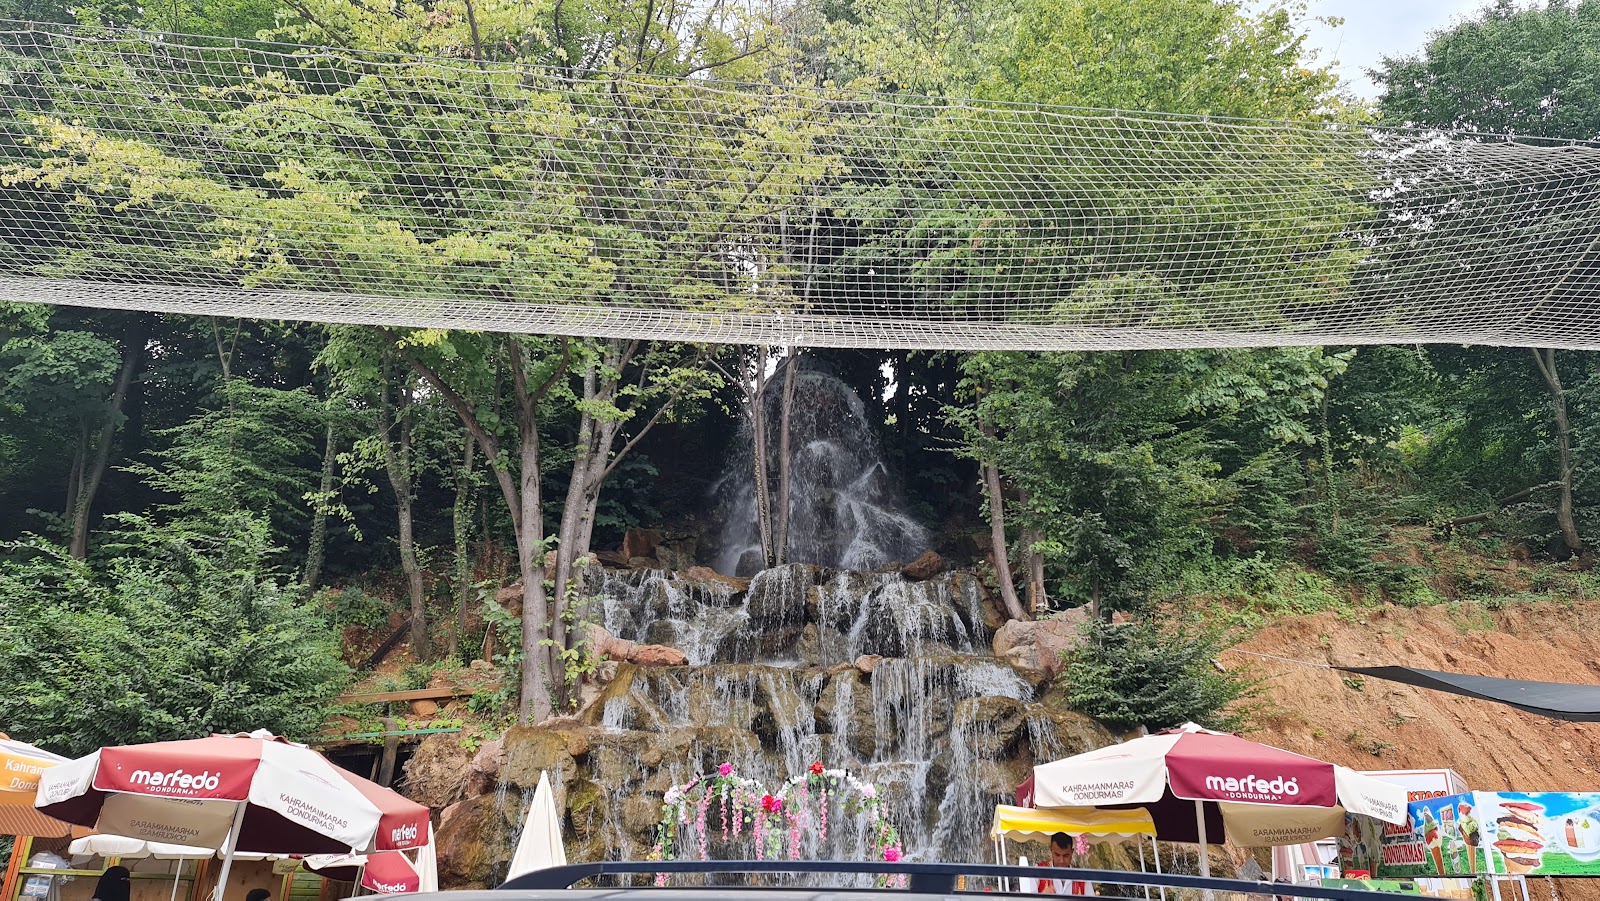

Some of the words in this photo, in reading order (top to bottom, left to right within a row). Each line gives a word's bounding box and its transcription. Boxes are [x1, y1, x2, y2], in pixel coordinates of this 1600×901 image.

[130, 769, 220, 790] marfedo
[1206, 774, 1299, 795] marfedo
[149, 785, 194, 795] DONDURMA
[1229, 792, 1277, 801] DONDURMA
[391, 822, 418, 842] marfedo
